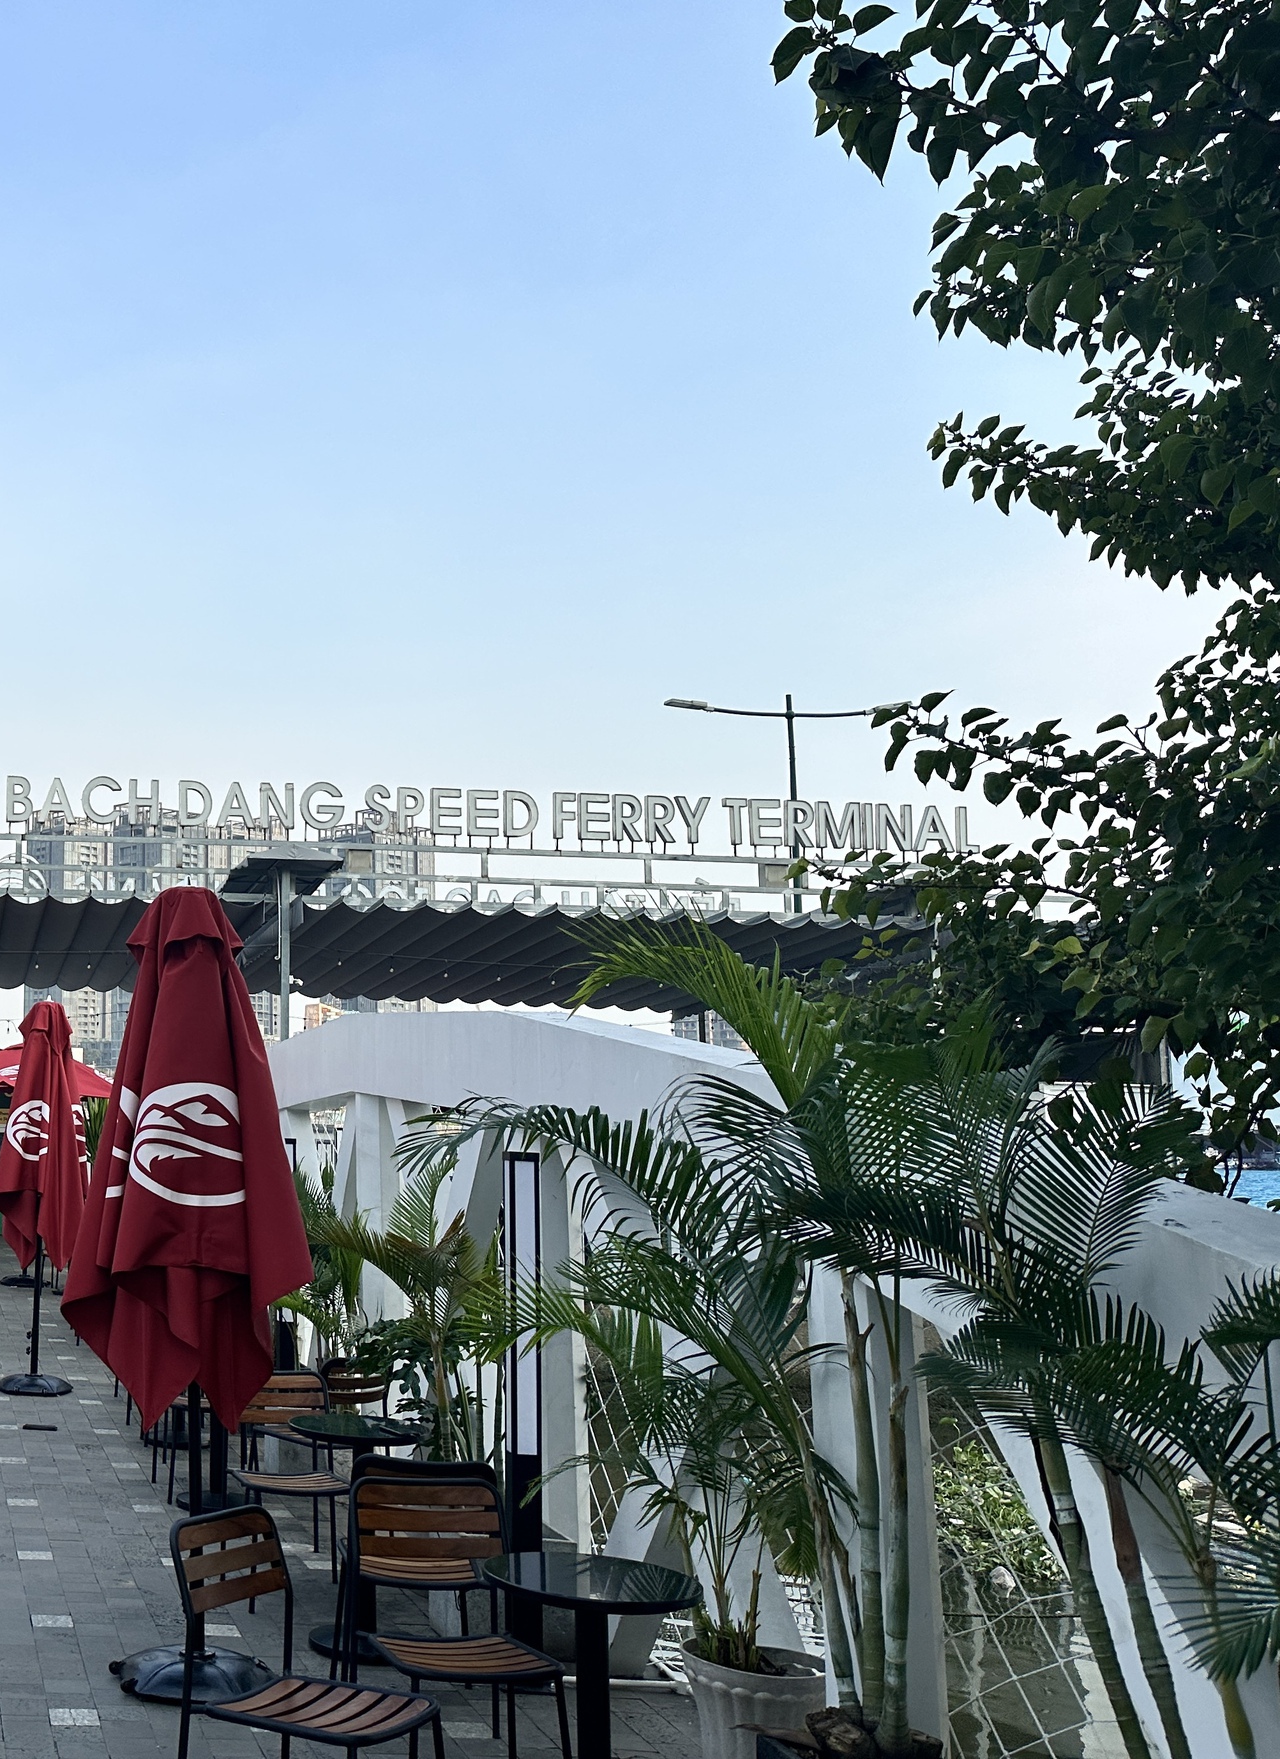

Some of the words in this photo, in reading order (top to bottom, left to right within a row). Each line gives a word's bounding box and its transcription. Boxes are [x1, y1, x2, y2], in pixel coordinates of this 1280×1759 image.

[5, 775, 160, 826] BACH
[178, 780, 346, 831] DANG
[364, 784, 539, 838] SPEED
[553, 791, 711, 844] FERRY
[721, 797, 980, 855] TERMINAL
